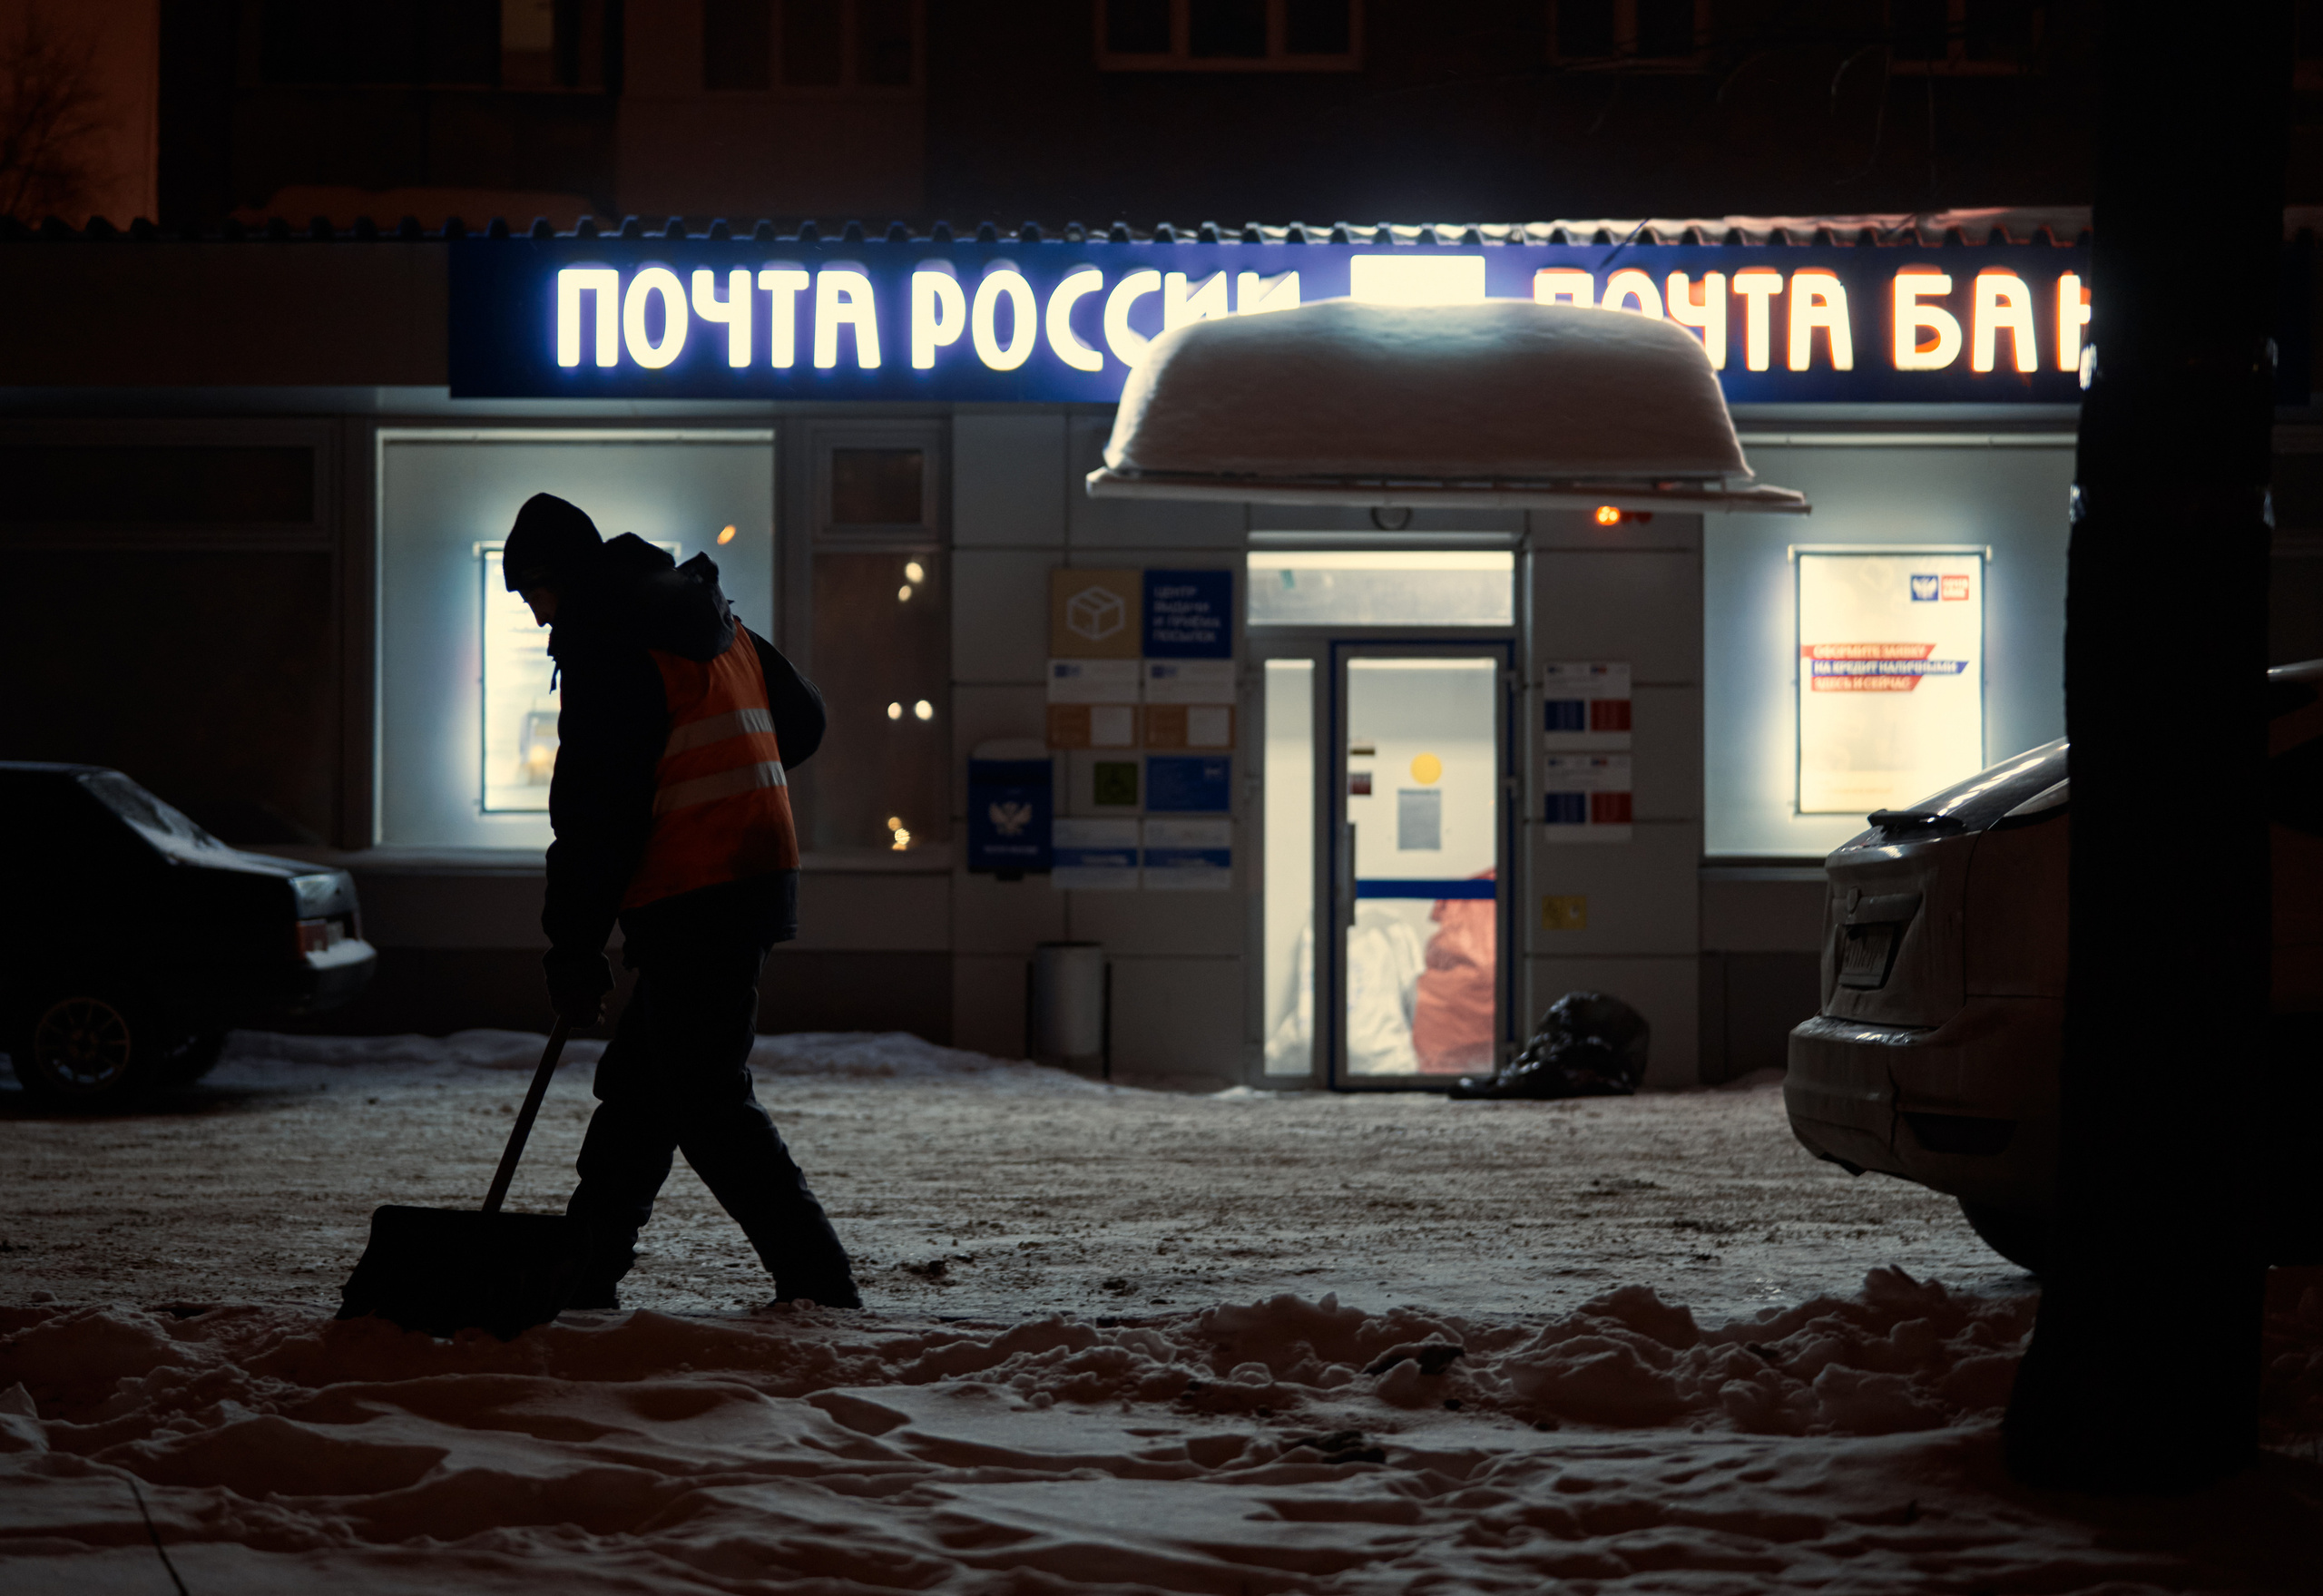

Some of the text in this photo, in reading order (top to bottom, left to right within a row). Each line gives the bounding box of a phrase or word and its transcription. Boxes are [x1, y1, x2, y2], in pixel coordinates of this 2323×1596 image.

[557, 268, 881, 369] ПОЧТА
[1813, 645, 1926, 659] ОФОРМИТЕ ЗАЯВКУ
[1814, 661, 1957, 675] НА КРЕДИТ НАЛИЧНЫМИ
[1853, 677, 1863, 690] И
